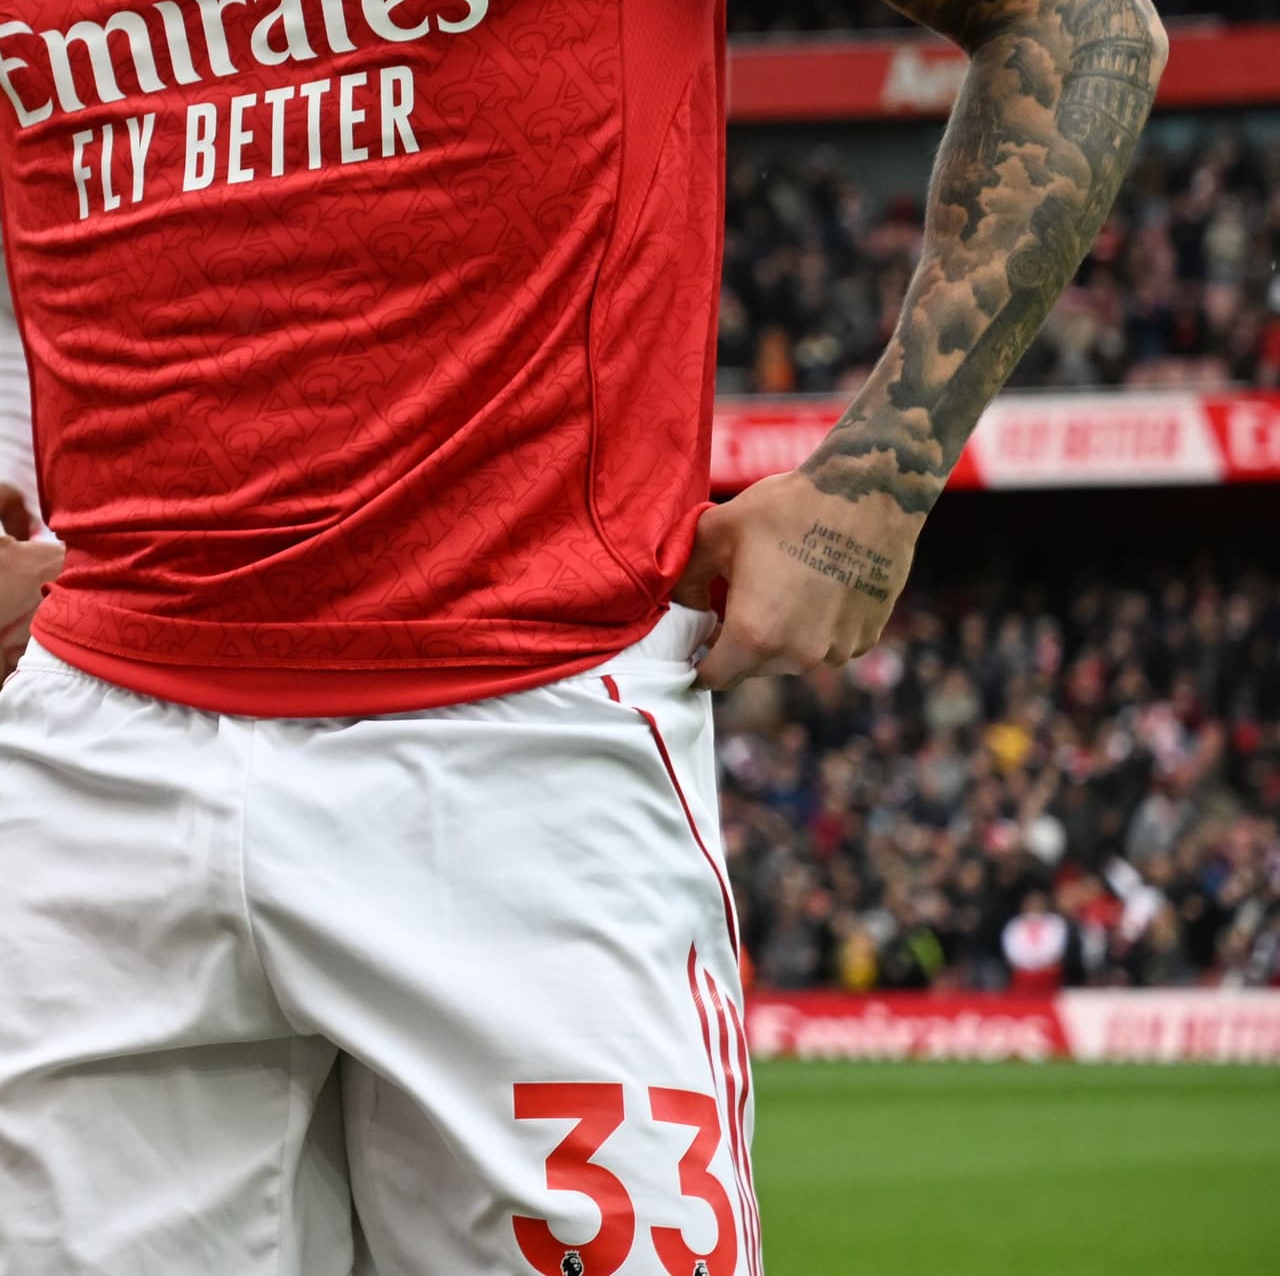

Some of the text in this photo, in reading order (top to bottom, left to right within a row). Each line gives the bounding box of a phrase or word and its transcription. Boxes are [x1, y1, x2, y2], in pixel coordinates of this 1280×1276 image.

[72, 65, 421, 221] FLY BETTER
[802, 533, 818, 549] to
[811, 519, 842, 543] just
[778, 539, 853, 585] collateral
[511, 1082, 738, 1276] 33
